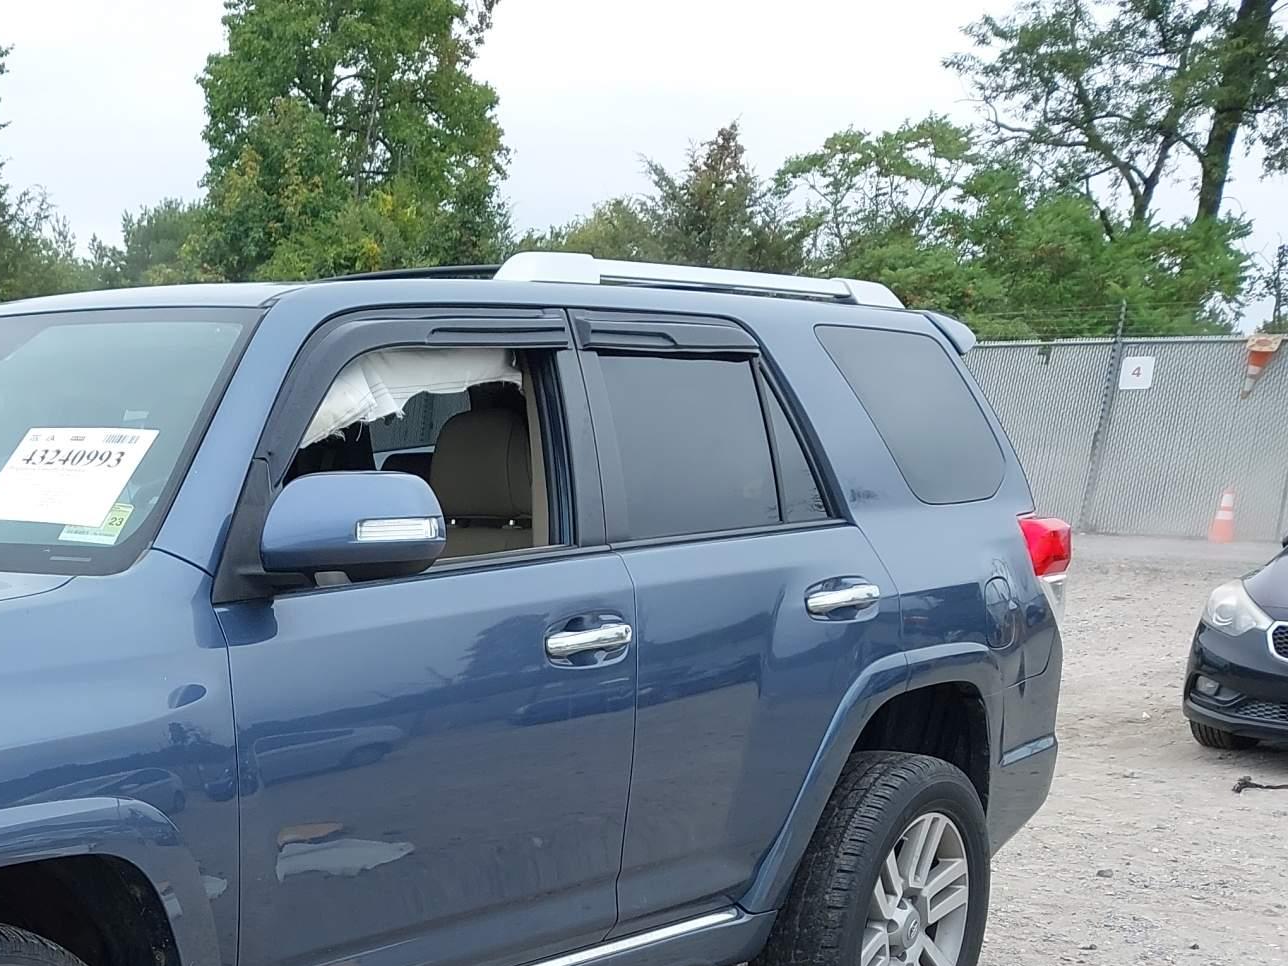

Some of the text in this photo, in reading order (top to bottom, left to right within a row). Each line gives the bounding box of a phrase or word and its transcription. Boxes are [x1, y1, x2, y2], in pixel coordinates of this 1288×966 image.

[1131, 366, 1142, 378] 4
[22, 448, 126, 468] 43240993
[108, 516, 125, 527] 23
